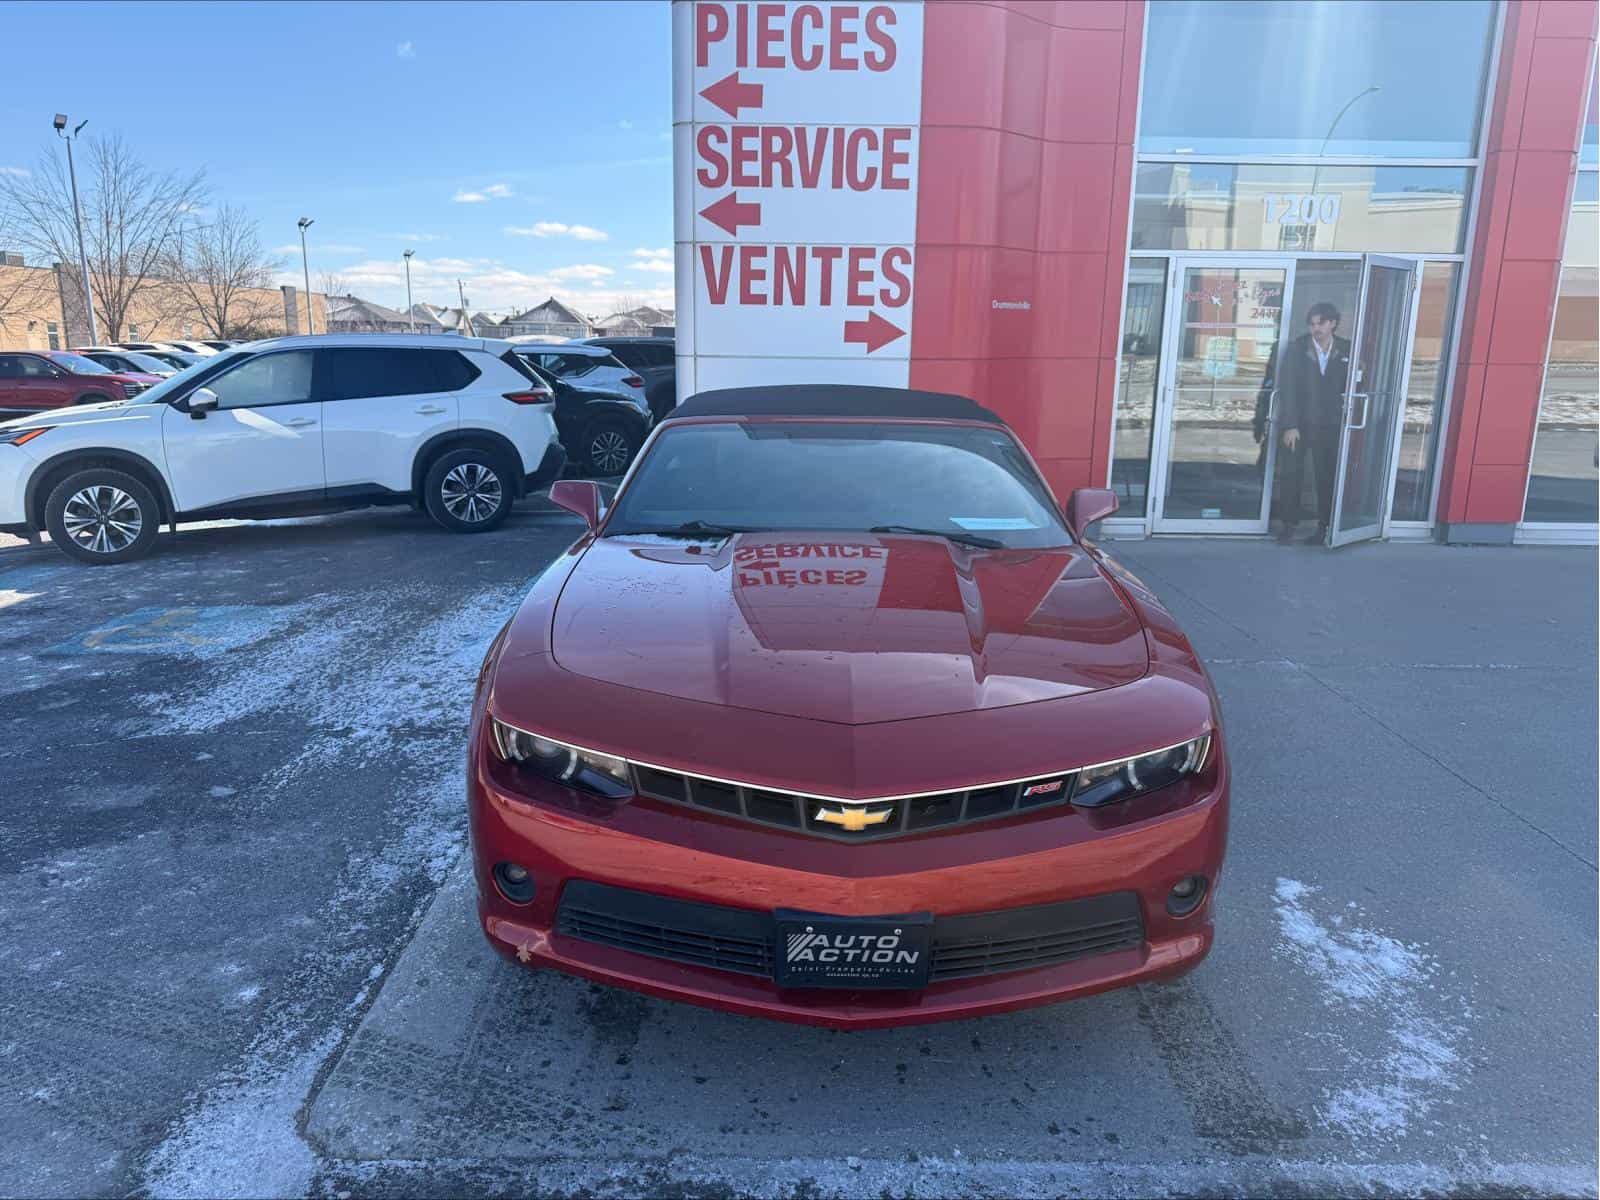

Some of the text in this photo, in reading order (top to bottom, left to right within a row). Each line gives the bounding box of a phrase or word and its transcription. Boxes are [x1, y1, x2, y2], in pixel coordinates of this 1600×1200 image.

[696, 125, 911, 191] SERVICE
[1262, 193, 1342, 225] 1200
[699, 245, 912, 308] VENTES
[795, 949, 919, 965] ACTION
[808, 934, 899, 949] AUTO
